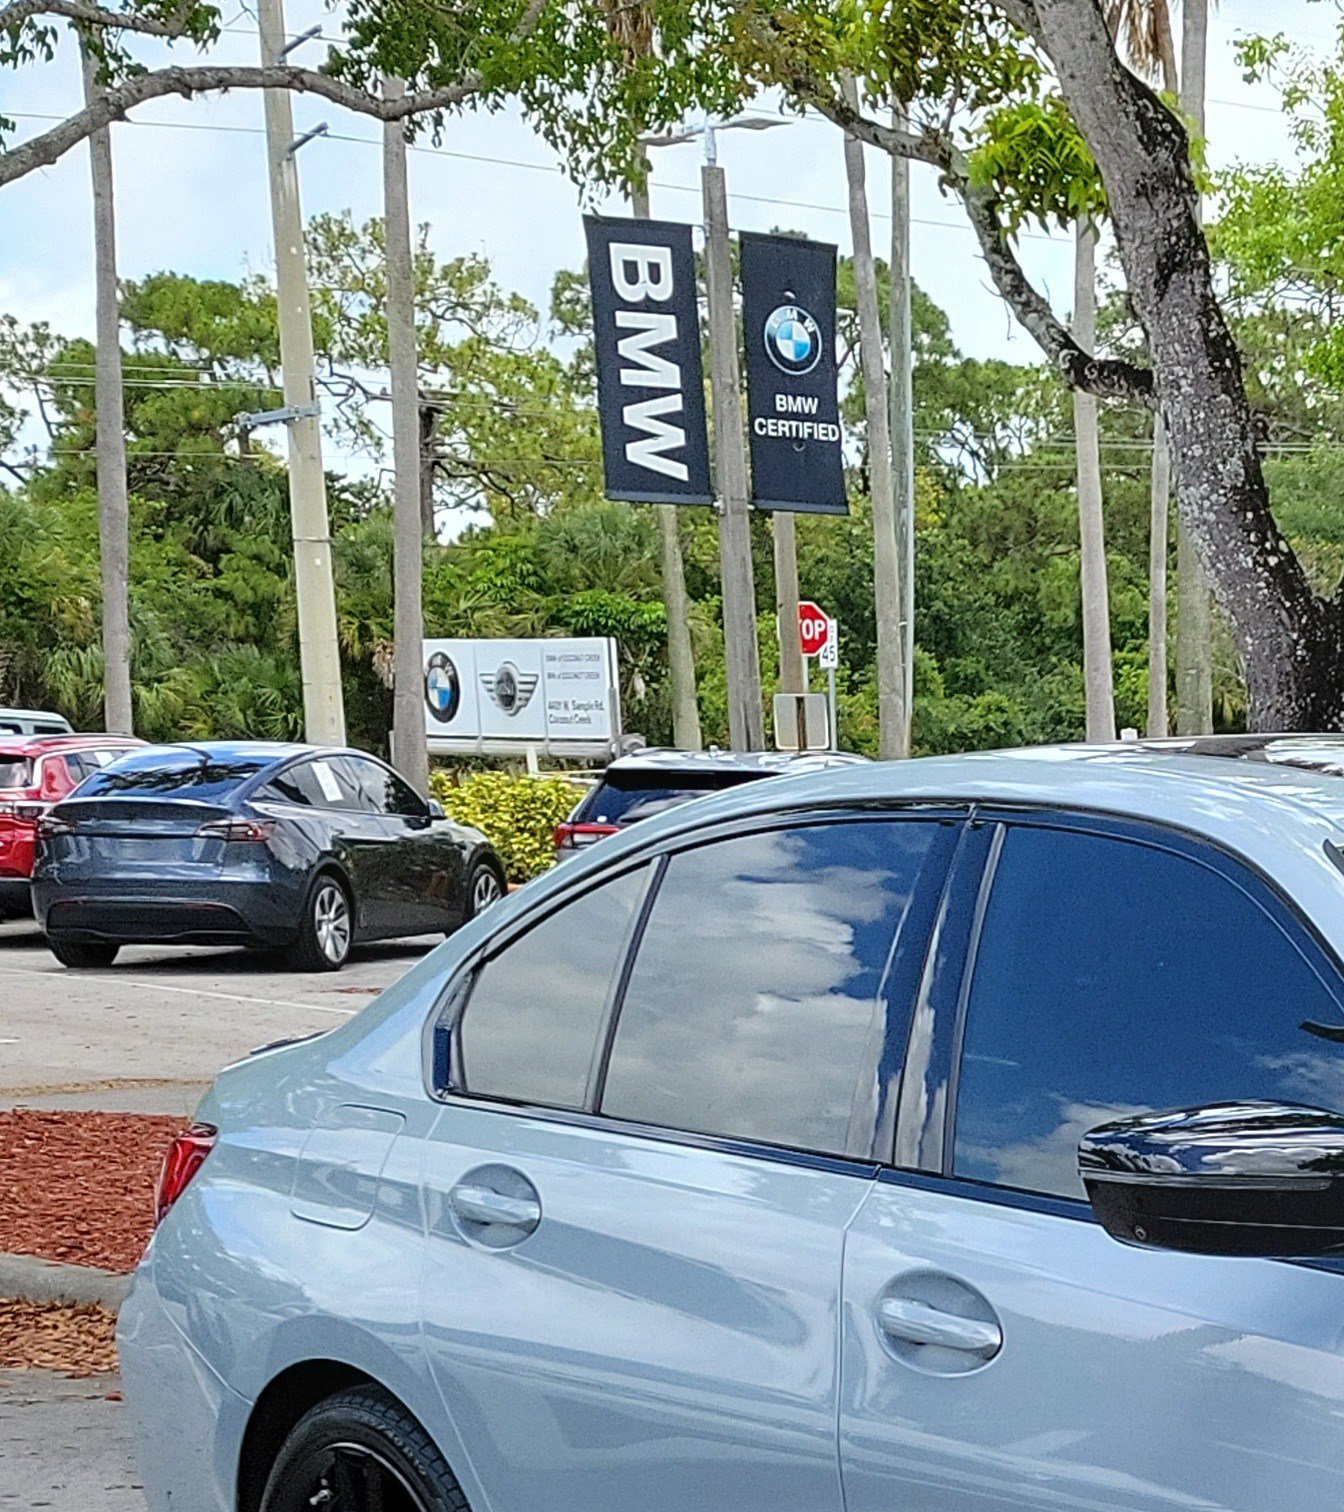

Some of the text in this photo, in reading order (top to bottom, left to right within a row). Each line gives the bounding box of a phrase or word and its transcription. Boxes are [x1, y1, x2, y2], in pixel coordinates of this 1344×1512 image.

[609, 242, 689, 482] BMW
[775, 394, 819, 415] BMW
[754, 417, 840, 442] CERTIFIED
[798, 618, 826, 640] OP
[822, 645, 836, 662] 45
